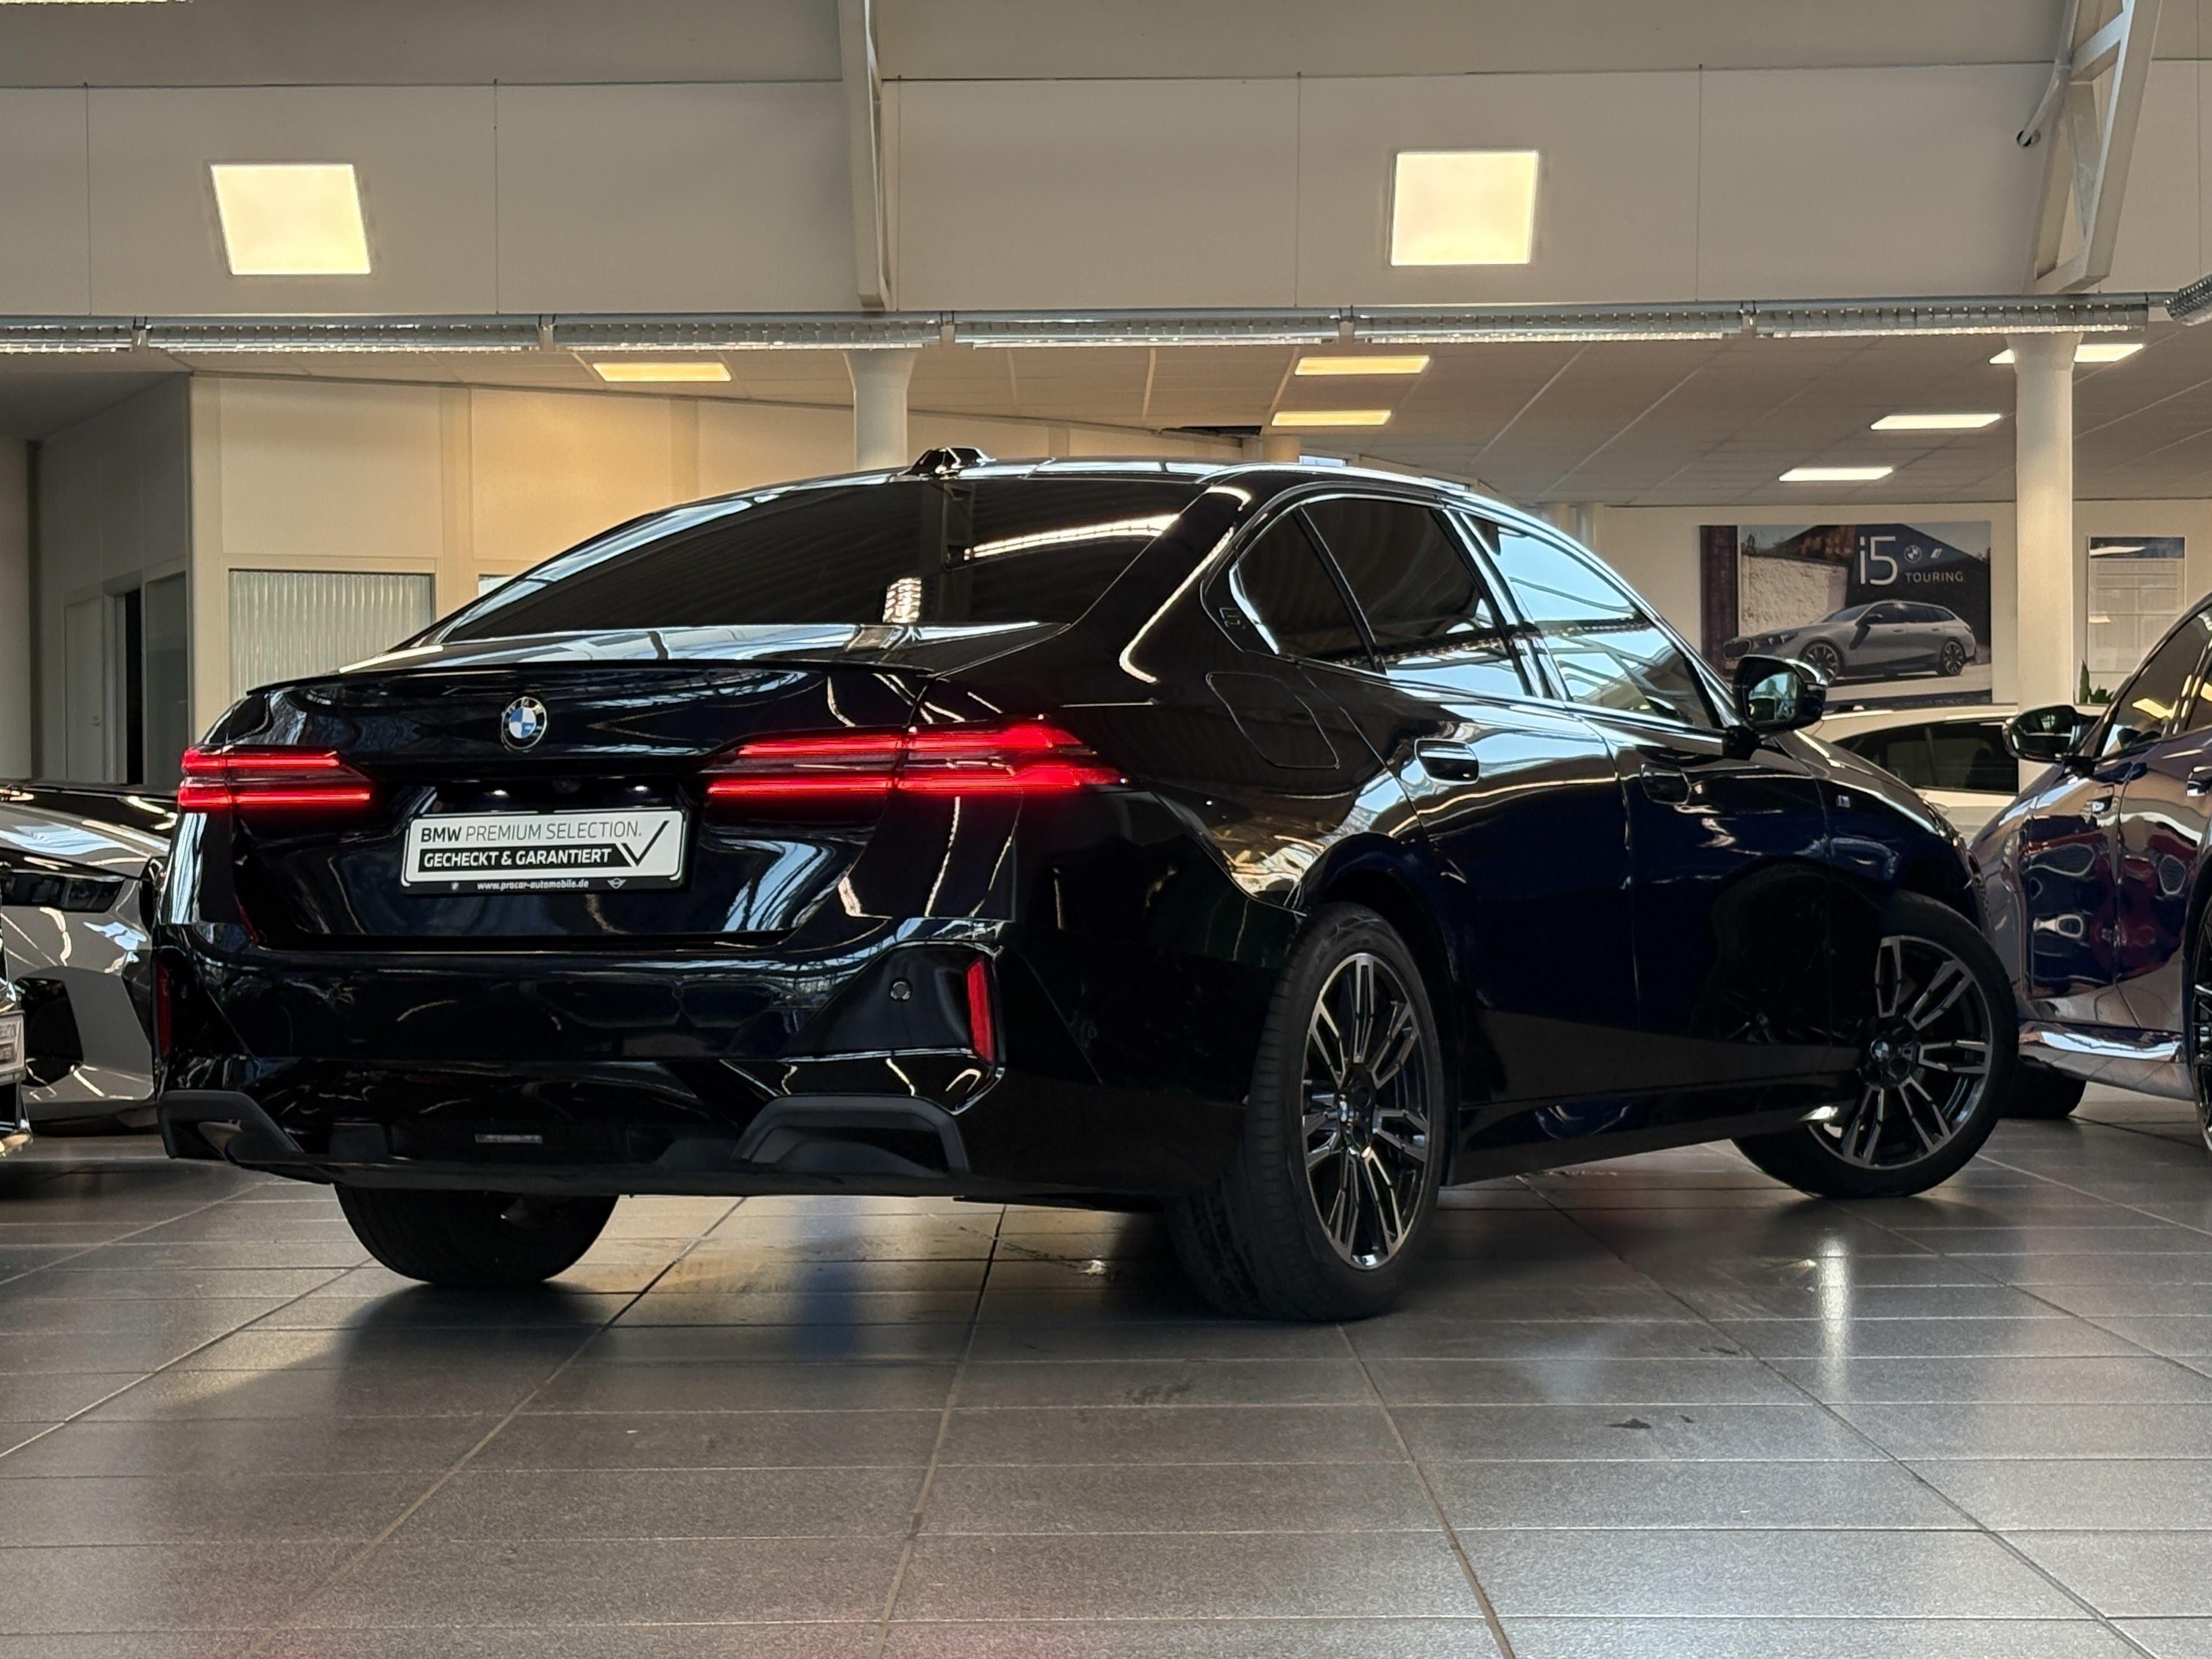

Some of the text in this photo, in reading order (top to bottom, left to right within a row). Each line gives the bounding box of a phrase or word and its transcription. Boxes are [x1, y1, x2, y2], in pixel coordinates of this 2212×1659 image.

[1860, 535, 1899, 585] i5
[1905, 571, 1963, 583] TOURING
[421, 821, 642, 843] BMW PREMIUM SELECTION.
[424, 848, 612, 868] GECHECKT & GARANTIERT
[477, 879, 590, 891] www.procar-automobile.de
